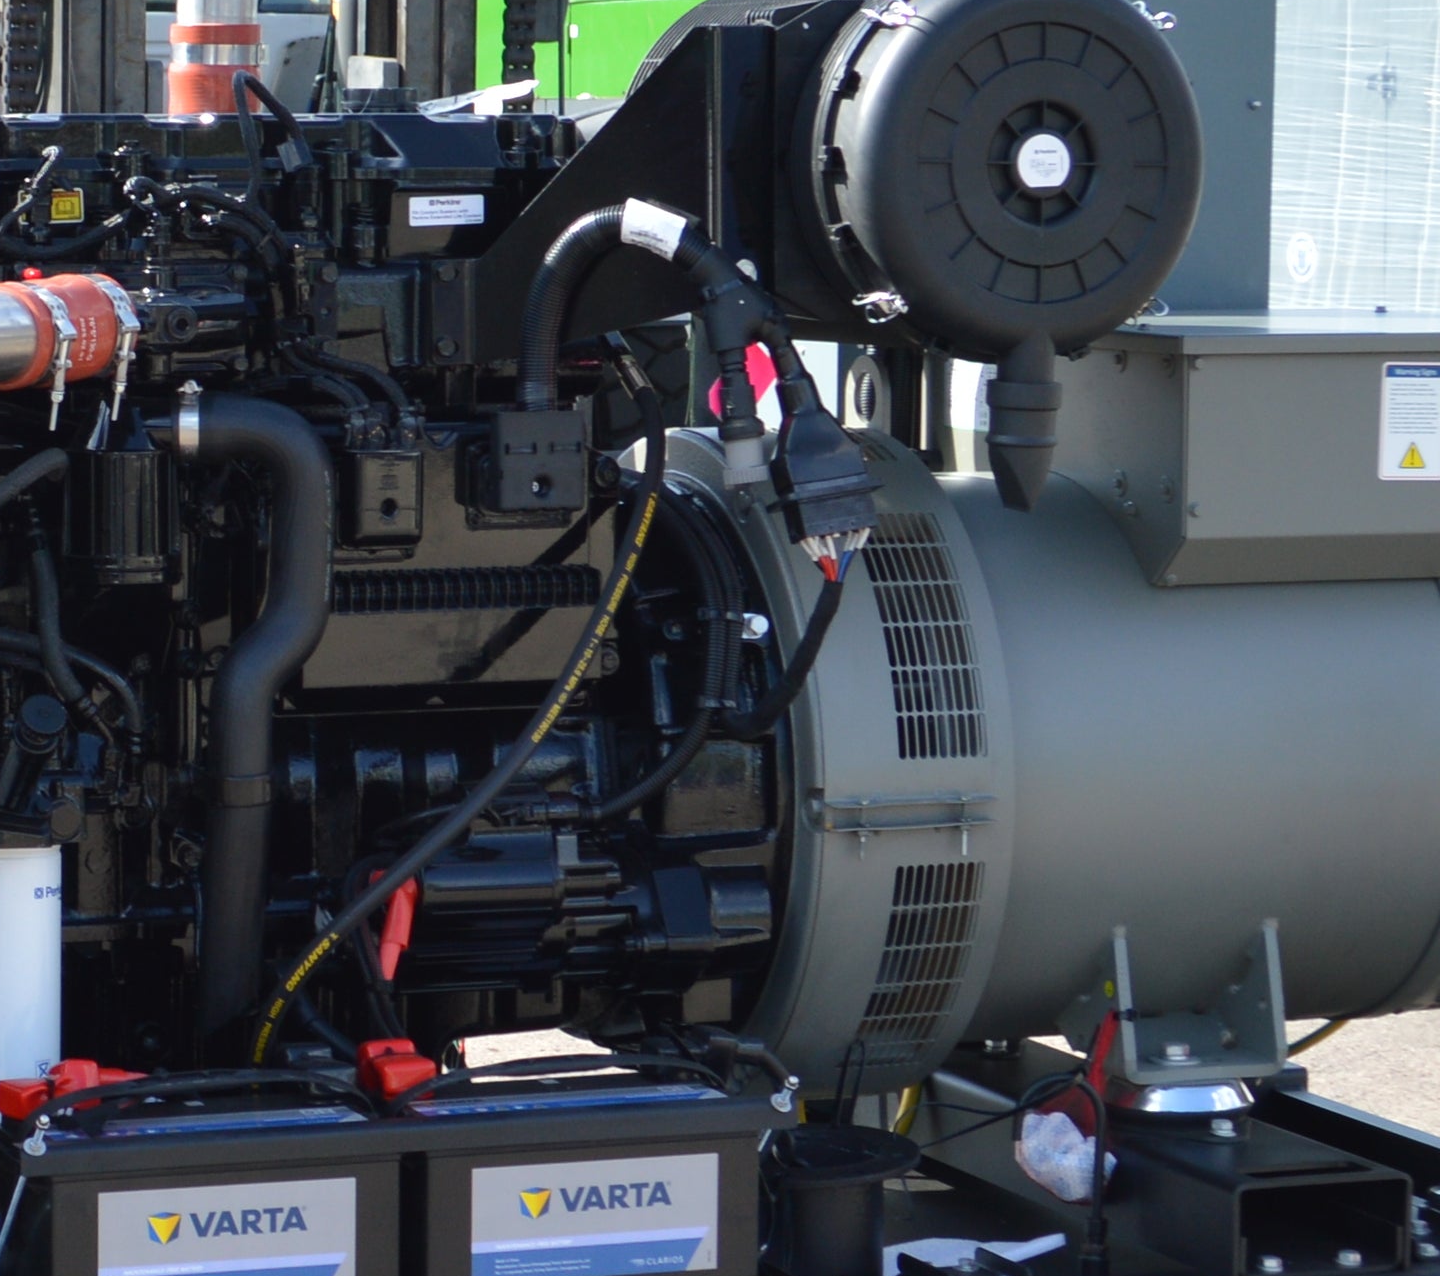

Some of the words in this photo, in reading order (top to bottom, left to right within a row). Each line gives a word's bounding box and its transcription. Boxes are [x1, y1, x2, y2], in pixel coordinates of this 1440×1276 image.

[285, 937, 331, 992] SANYANG
[268, 997, 285, 1019] HIGH
[559, 1181, 672, 1212] VARTA
[189, 1206, 308, 1238] VARTA
[646, 1254, 684, 1266] CLARIOS
